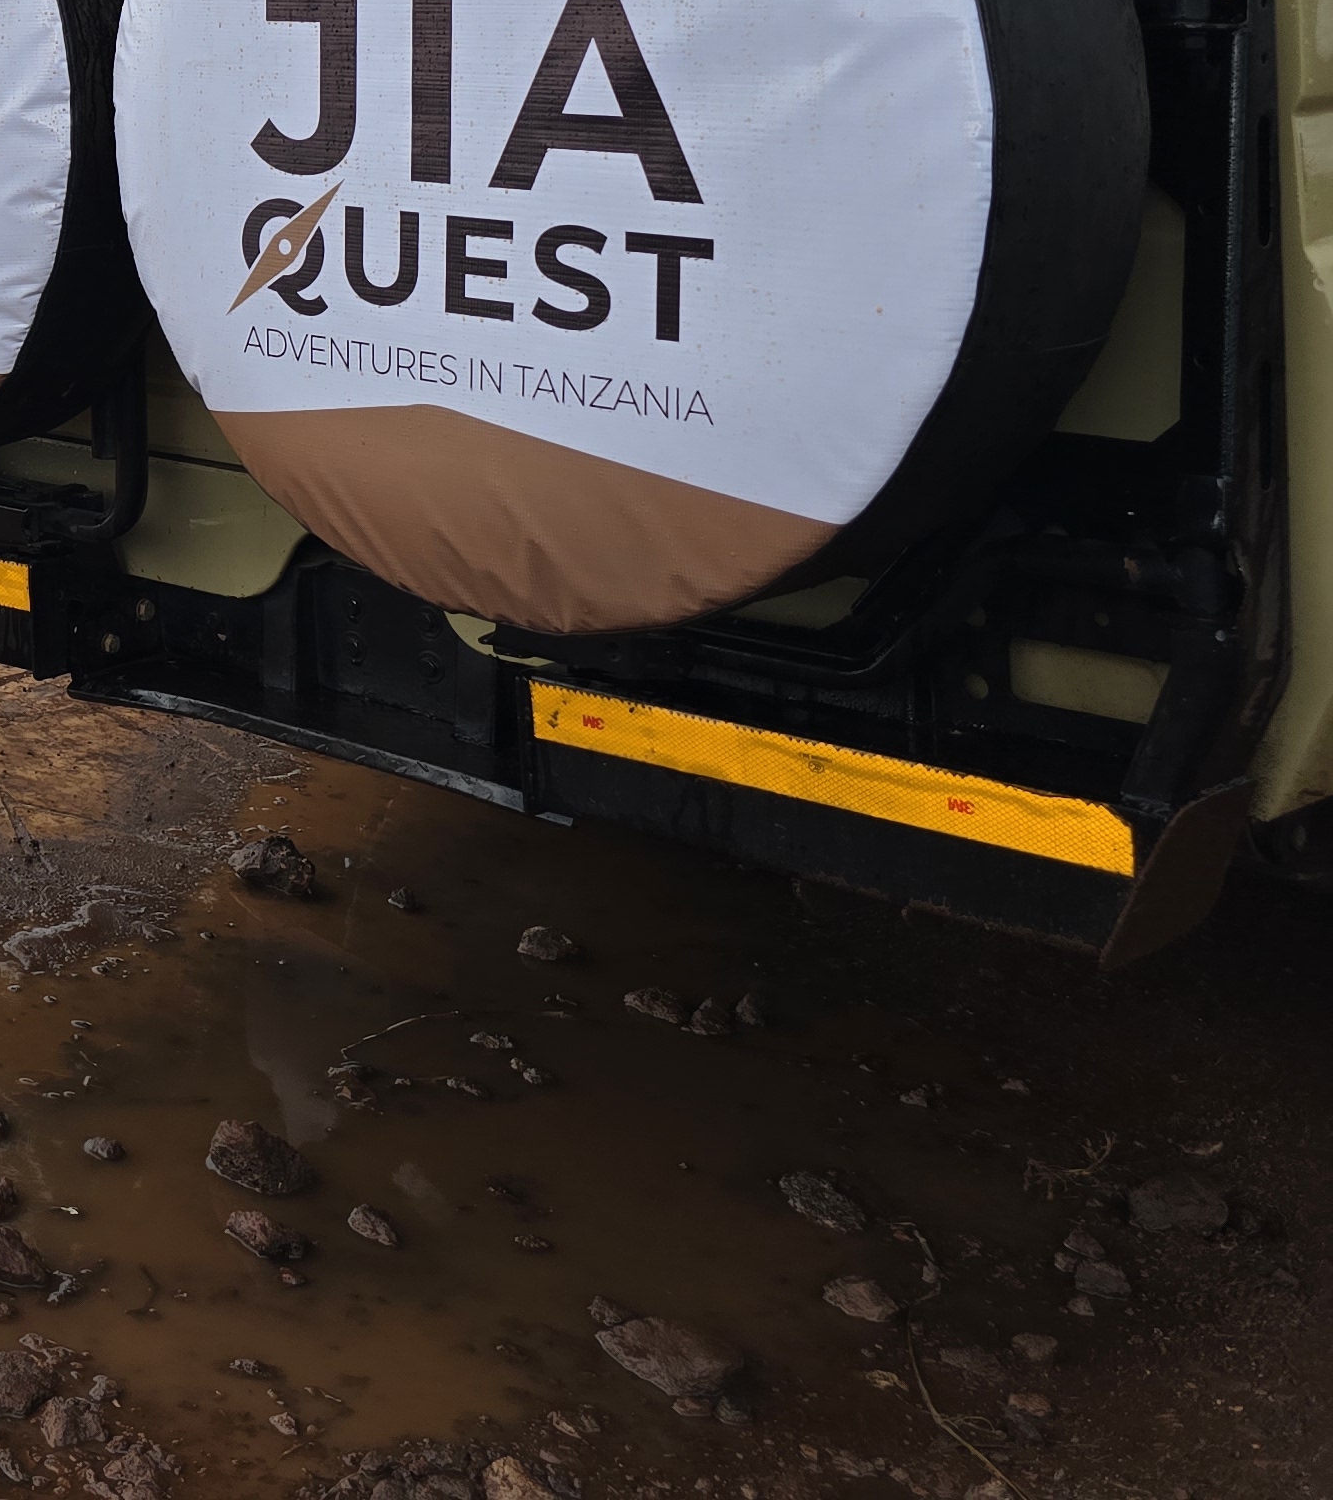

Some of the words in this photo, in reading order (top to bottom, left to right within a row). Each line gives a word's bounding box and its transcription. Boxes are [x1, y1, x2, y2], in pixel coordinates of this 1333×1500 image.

[241, 197, 715, 343] QUEST
[243, 325, 458, 387] ADVENTURES
[468, 357, 503, 395] IN
[512, 363, 714, 426] TANZANIA
[582, 714, 605, 731] 3M
[946, 796, 975, 815] 3M
